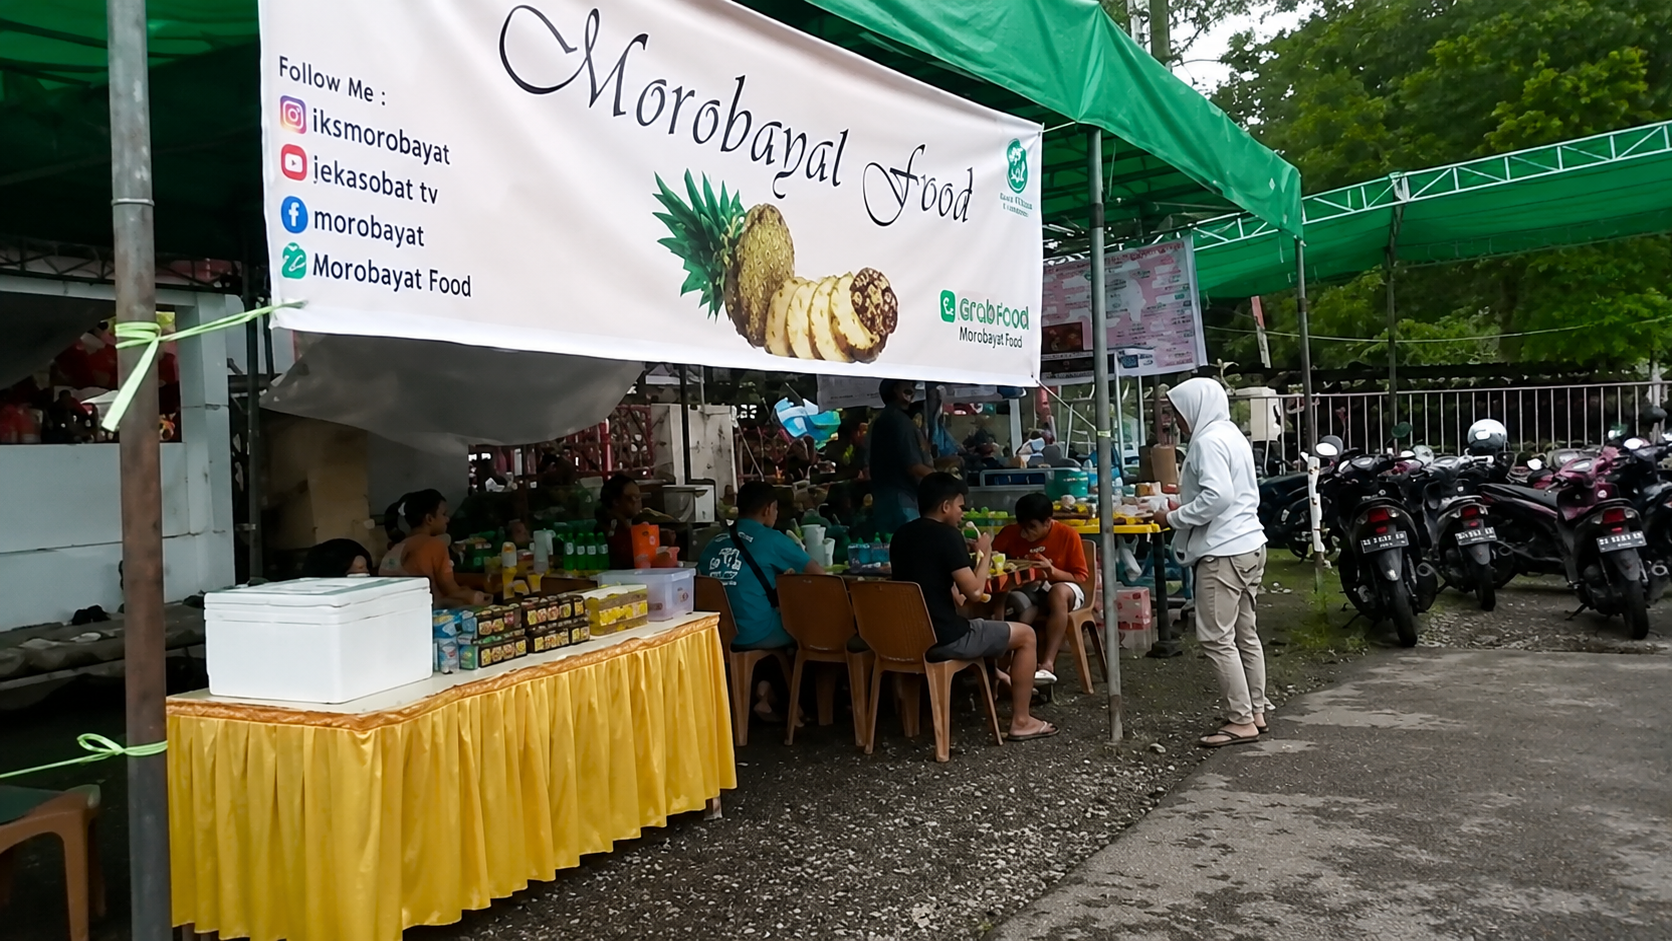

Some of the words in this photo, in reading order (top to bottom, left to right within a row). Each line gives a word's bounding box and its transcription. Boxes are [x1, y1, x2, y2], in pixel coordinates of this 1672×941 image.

[279, 55, 341, 93] Follow
[348, 76, 374, 103] Me
[312, 107, 451, 166] iksmorobayat
[312, 155, 414, 201] jekasobat
[419, 181, 439, 205] tv
[862, 144, 974, 227] Food
[314, 210, 425, 249] morobayat
[312, 252, 423, 293] Morobayat
[429, 268, 472, 298] Food
[959, 298, 1030, 331] GrabFood
[959, 325, 1004, 349] Morobayat
[1005, 332, 1023, 349] Food
